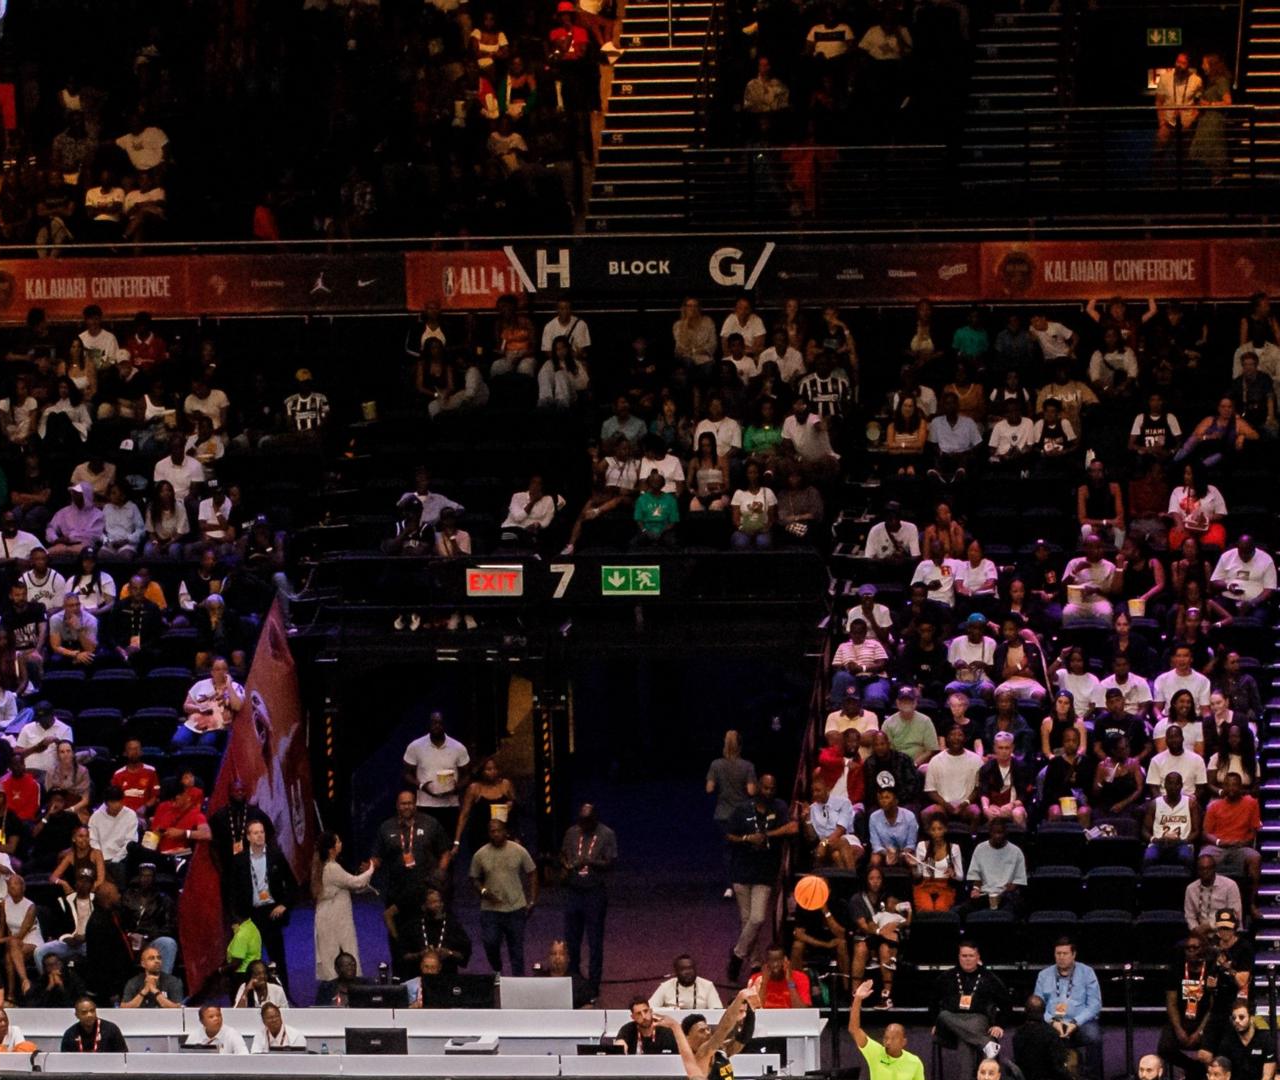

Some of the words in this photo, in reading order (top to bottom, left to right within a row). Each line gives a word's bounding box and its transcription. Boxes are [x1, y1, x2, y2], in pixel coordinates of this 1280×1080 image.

[536, 248, 571, 288] H
[608, 260, 671, 275] BLOCK
[708, 247, 745, 286] G
[1044, 260, 1108, 282] KALAHARI
[1113, 259, 1195, 281] CONFERENCE
[25, 277, 87, 299] KALAHARI
[91, 275, 171, 298] CONFERENCE
[469, 572, 518, 592] EXIT
[549, 563, 576, 599] 7
